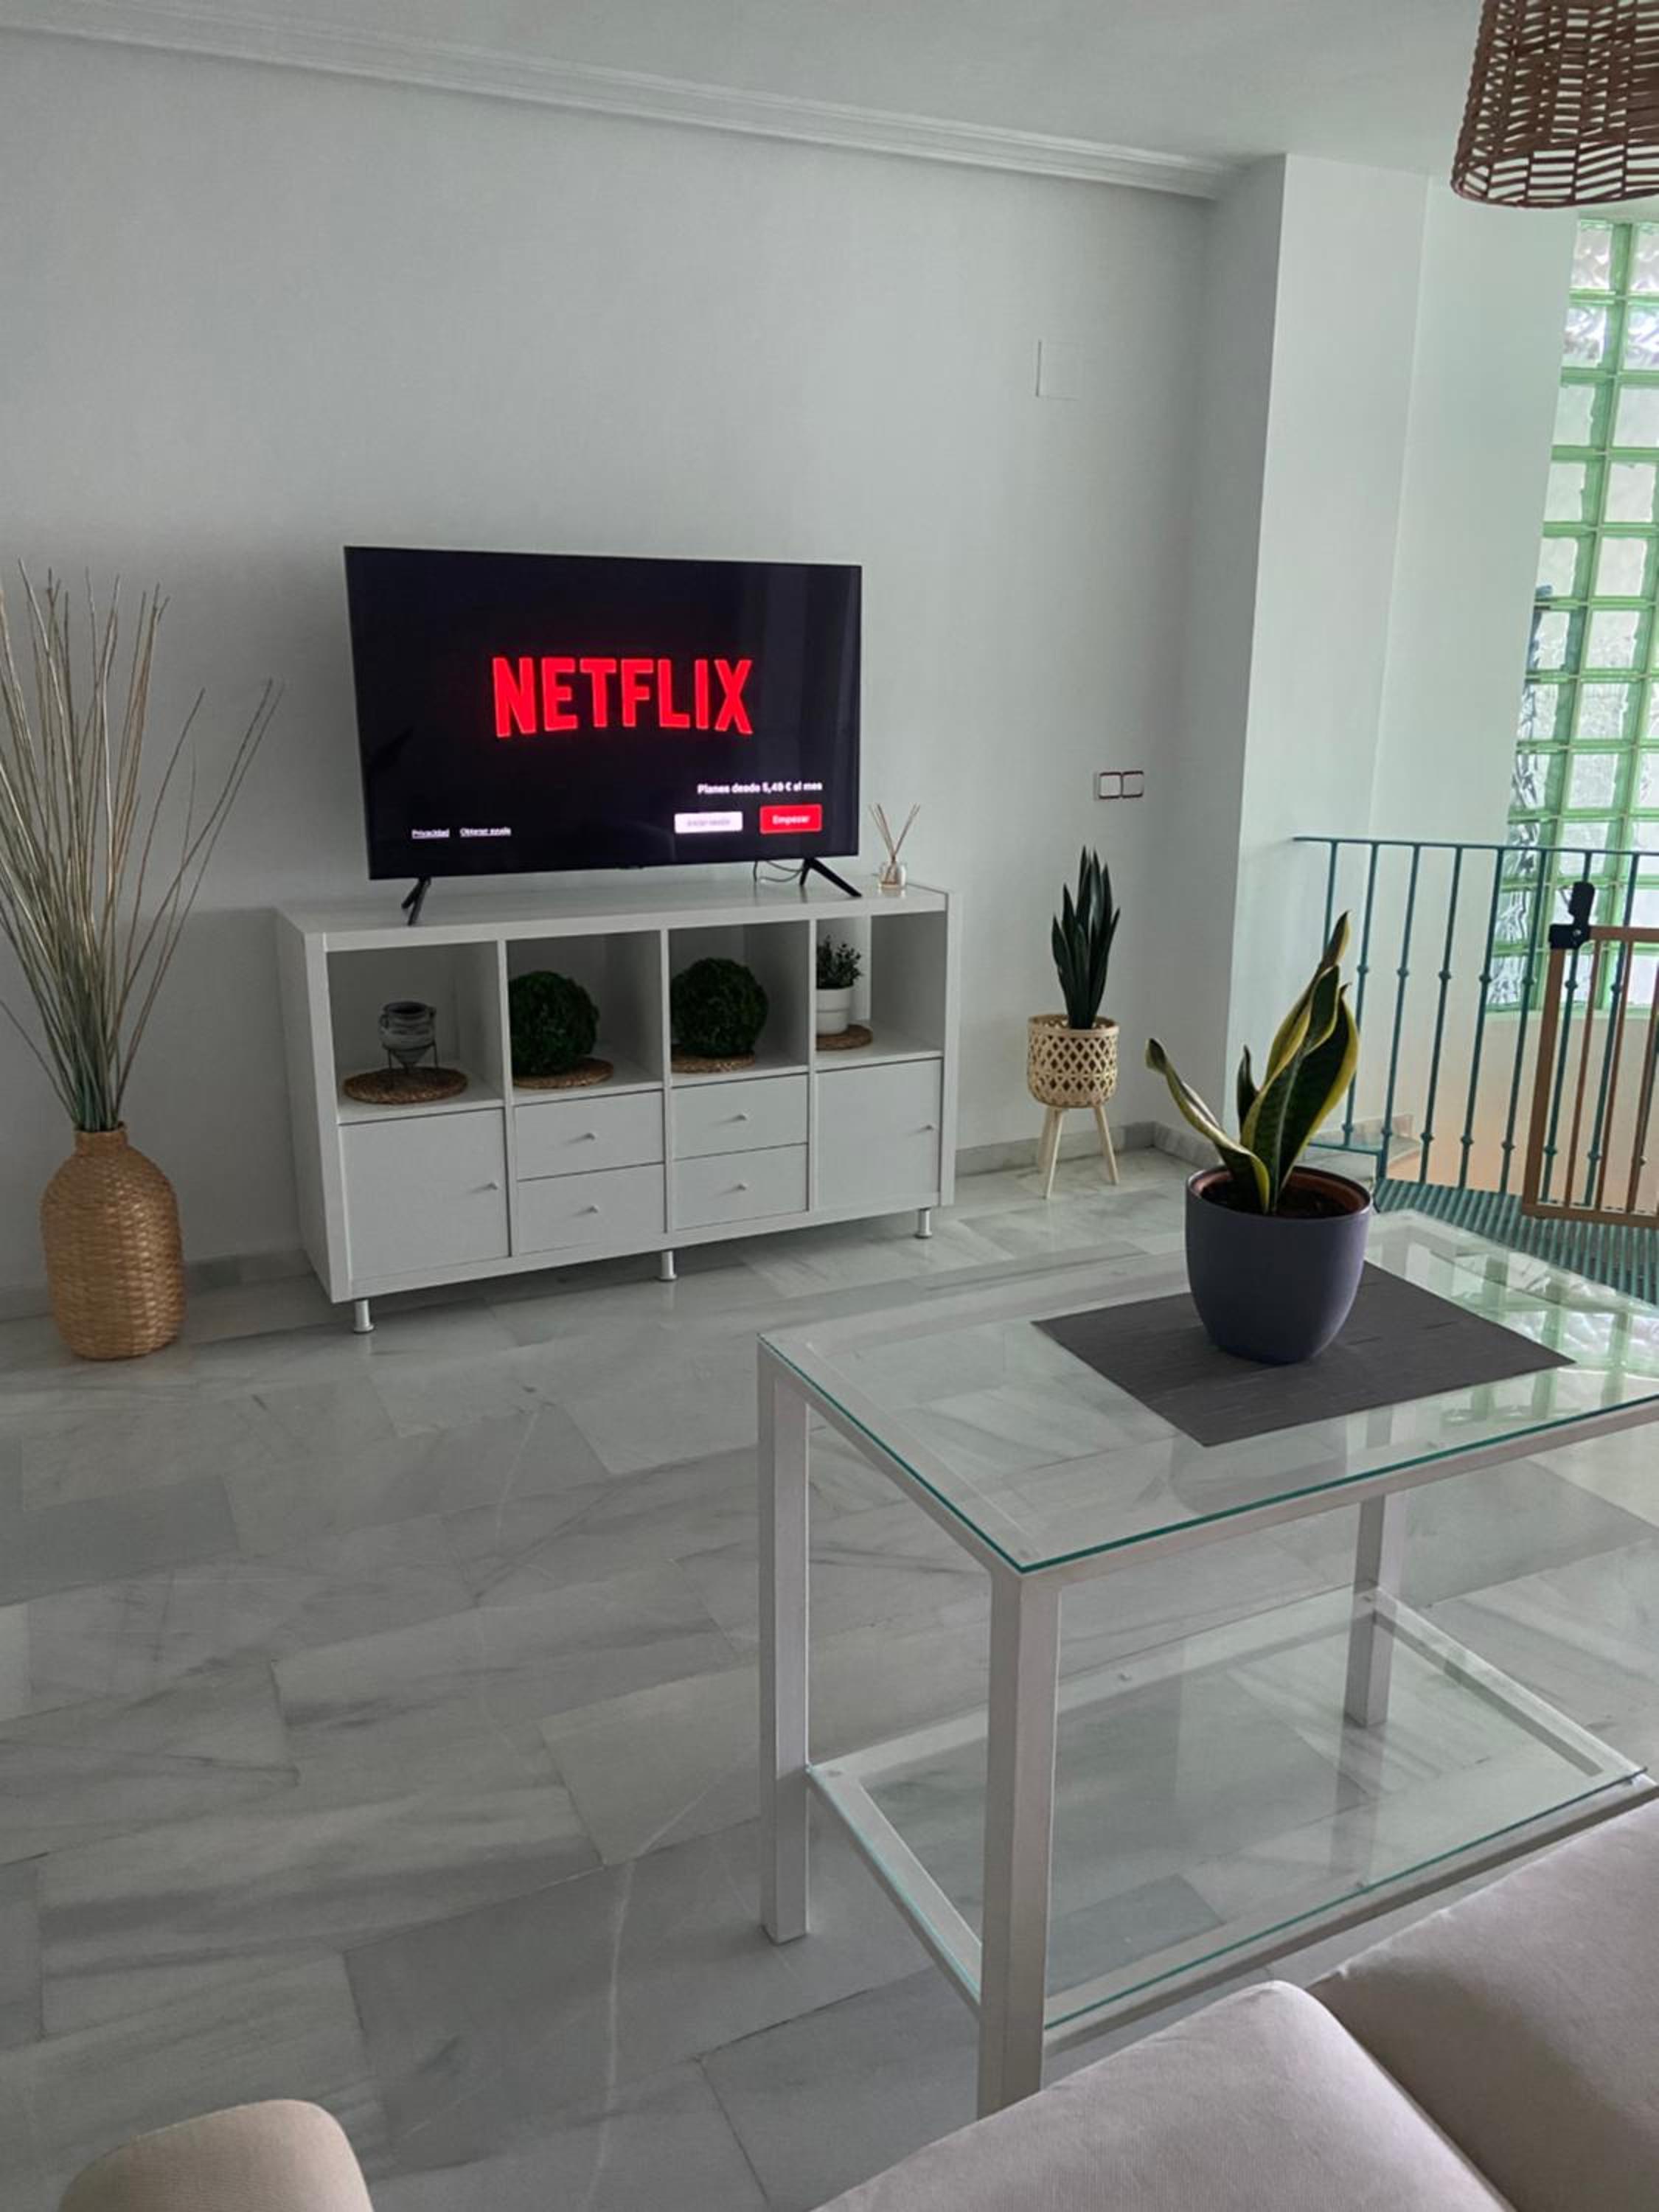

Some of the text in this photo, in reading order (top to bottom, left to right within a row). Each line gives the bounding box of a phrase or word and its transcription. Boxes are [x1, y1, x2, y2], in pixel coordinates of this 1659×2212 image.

[492, 655, 753, 738] NETFLIX
[697, 784, 730, 794] Planes
[731, 782, 761, 793] desde
[785, 782, 792, 791] €
[803, 782, 822, 791] mes
[772, 814, 810, 825] Empezar
